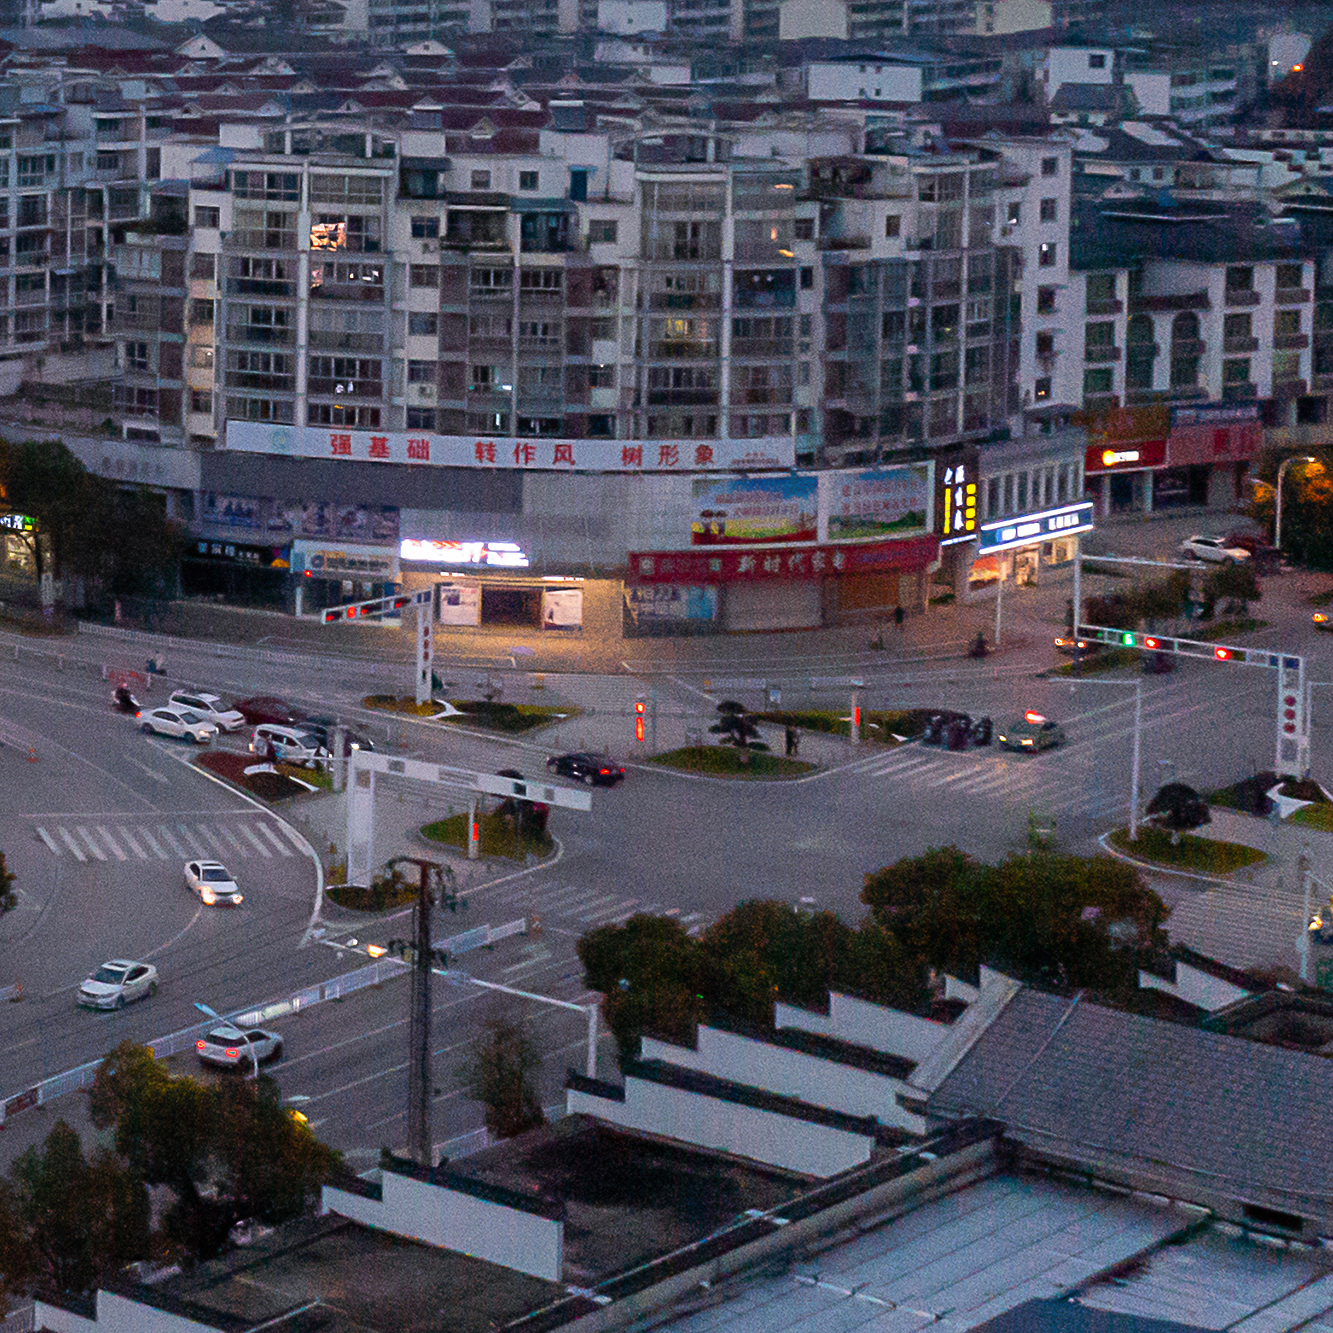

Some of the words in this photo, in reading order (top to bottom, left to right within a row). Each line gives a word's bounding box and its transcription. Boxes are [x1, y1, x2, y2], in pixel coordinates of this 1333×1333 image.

[329, 433, 430, 461] 强基础
[474, 441, 576, 465] 转作风
[621, 444, 715, 467] 树形象
